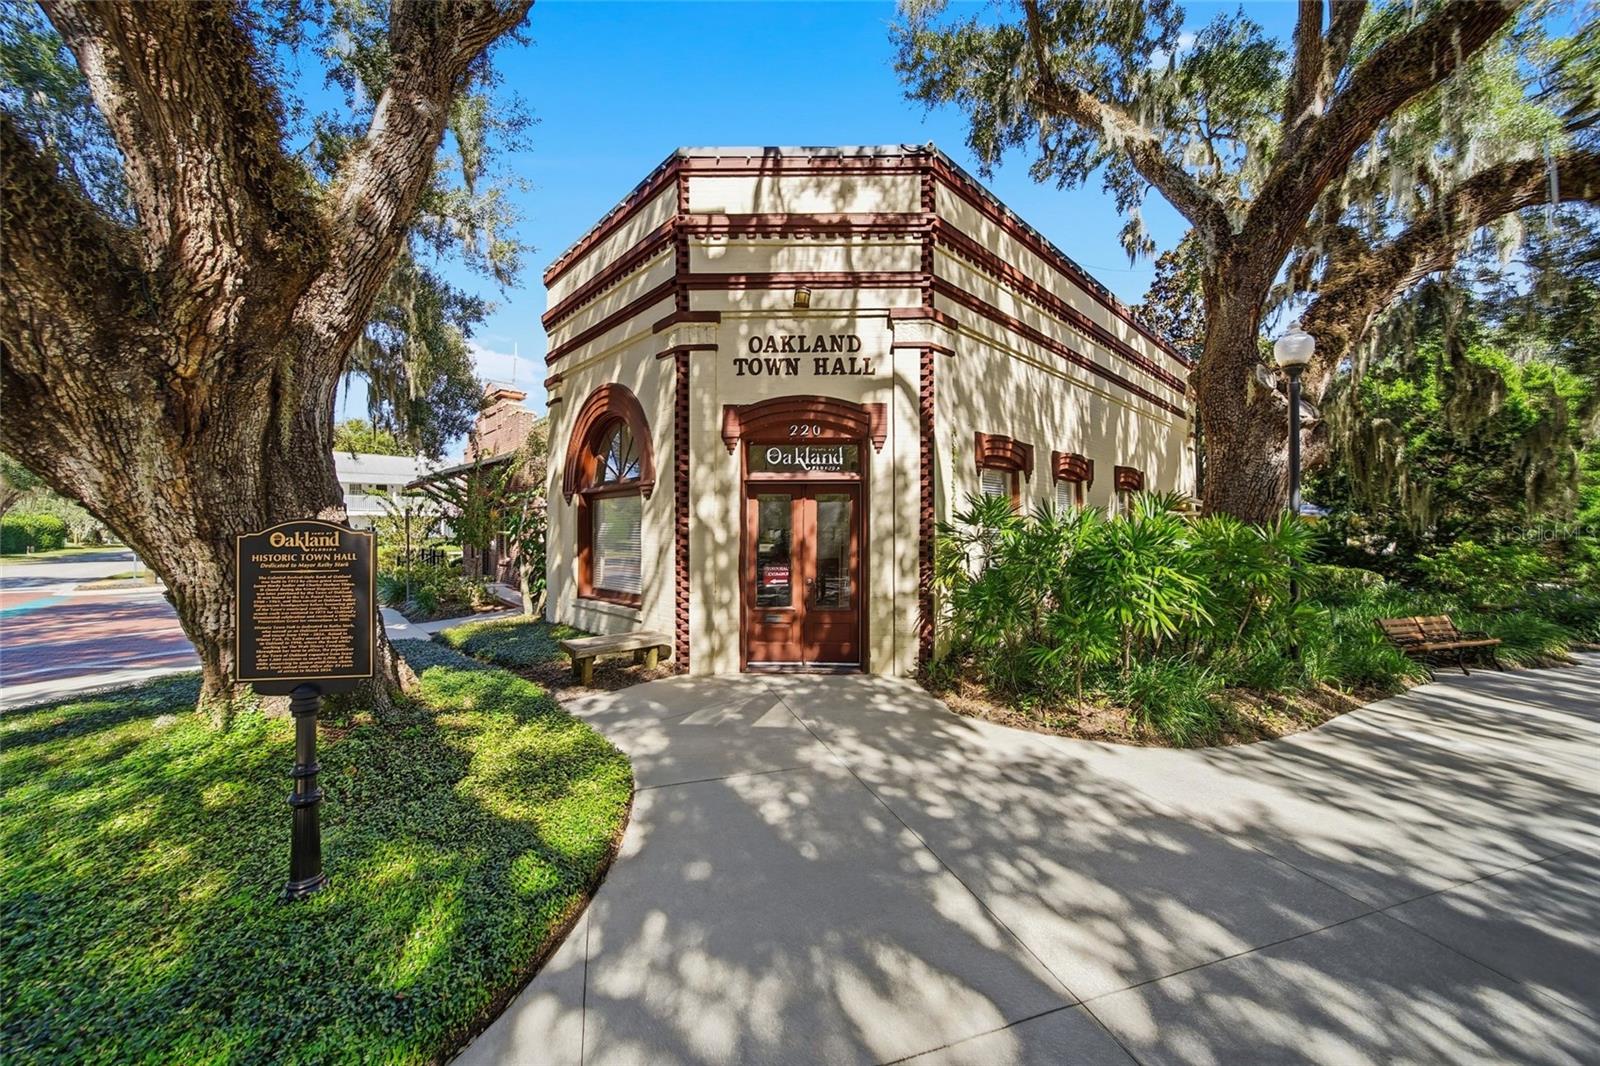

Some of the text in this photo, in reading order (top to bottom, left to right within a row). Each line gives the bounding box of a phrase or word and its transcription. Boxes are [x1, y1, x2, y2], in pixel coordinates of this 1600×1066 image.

[748, 334, 862, 354] OAKLAND
[733, 357, 876, 376] TOWN HALL
[789, 424, 821, 436] 220
[767, 446, 843, 470] Oakland
[270, 531, 340, 552] Oakland
[252, 553, 358, 562] HISTORIC TOWN HALL
